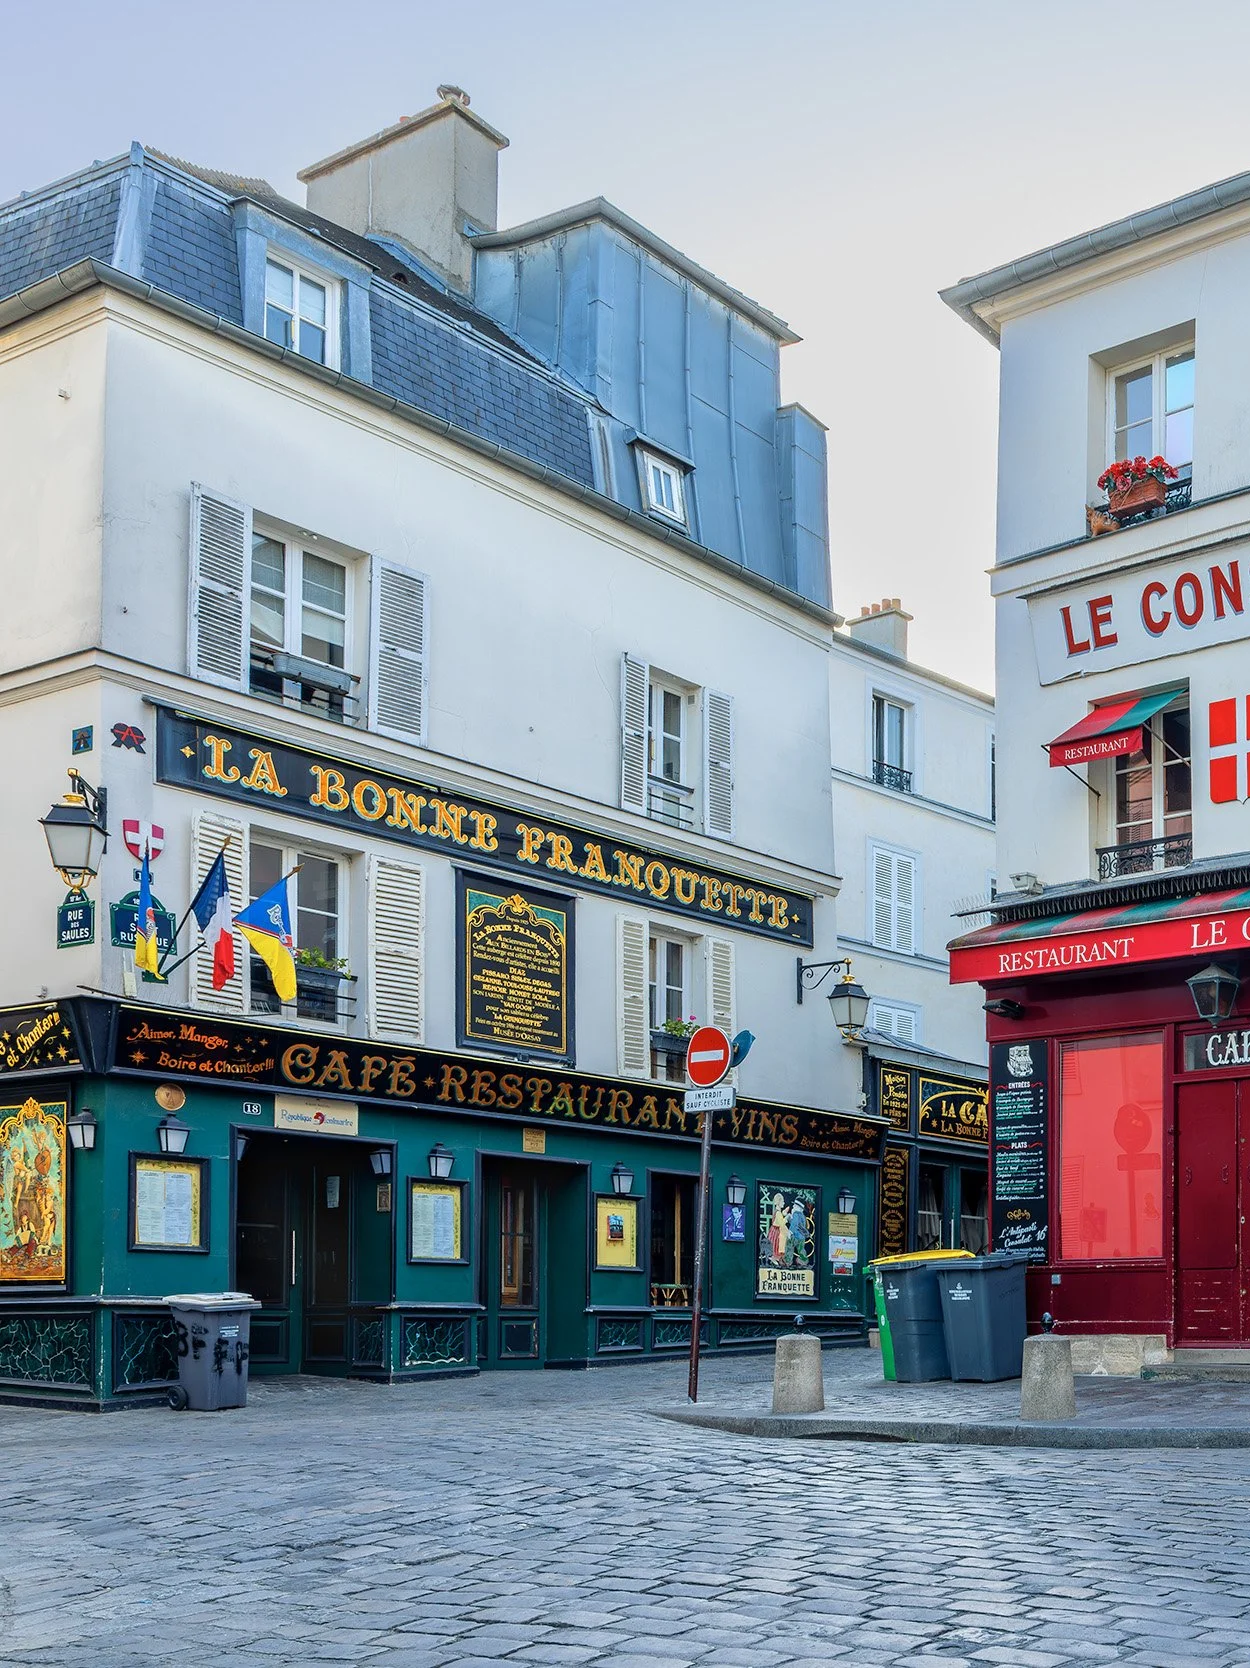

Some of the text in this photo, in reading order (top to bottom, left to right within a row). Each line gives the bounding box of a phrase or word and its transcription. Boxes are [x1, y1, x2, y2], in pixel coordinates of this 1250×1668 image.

[1060, 594, 1118, 656] LE
[1064, 736, 1129, 760] RESTAURANT
[202, 734, 789, 930] LA BONNE FRANQUETTE
[67, 909, 84, 921] RUE
[61, 927, 90, 941] SAULES
[998, 937, 1134, 974] RESTAURANT
[1190, 920, 1228, 950] LE
[6, 1047, 20, 1067] et
[156, 1051, 196, 1070] Boire
[199, 1059, 213, 1073] et
[884, 1074, 906, 1086] Maison
[1008, 1081, 1031, 1089] ENTRÉES
[280, 1042, 417, 1099] CAFÉ
[731, 1107, 799, 1145] VINS
[694, 1091, 722, 1100] INTERDIT
[245, 1103, 259, 1113] 18
[686, 1101, 701, 1109] SAUF
[941, 1100, 956, 1118] LA
[941, 1120, 954, 1132] LA
[955, 1122, 982, 1137] BONNE
[1011, 1141, 1028, 1149] PLATS
[767, 1271, 806, 1281] LA BONNE
[762, 1280, 810, 1292] FRANQUETTE
